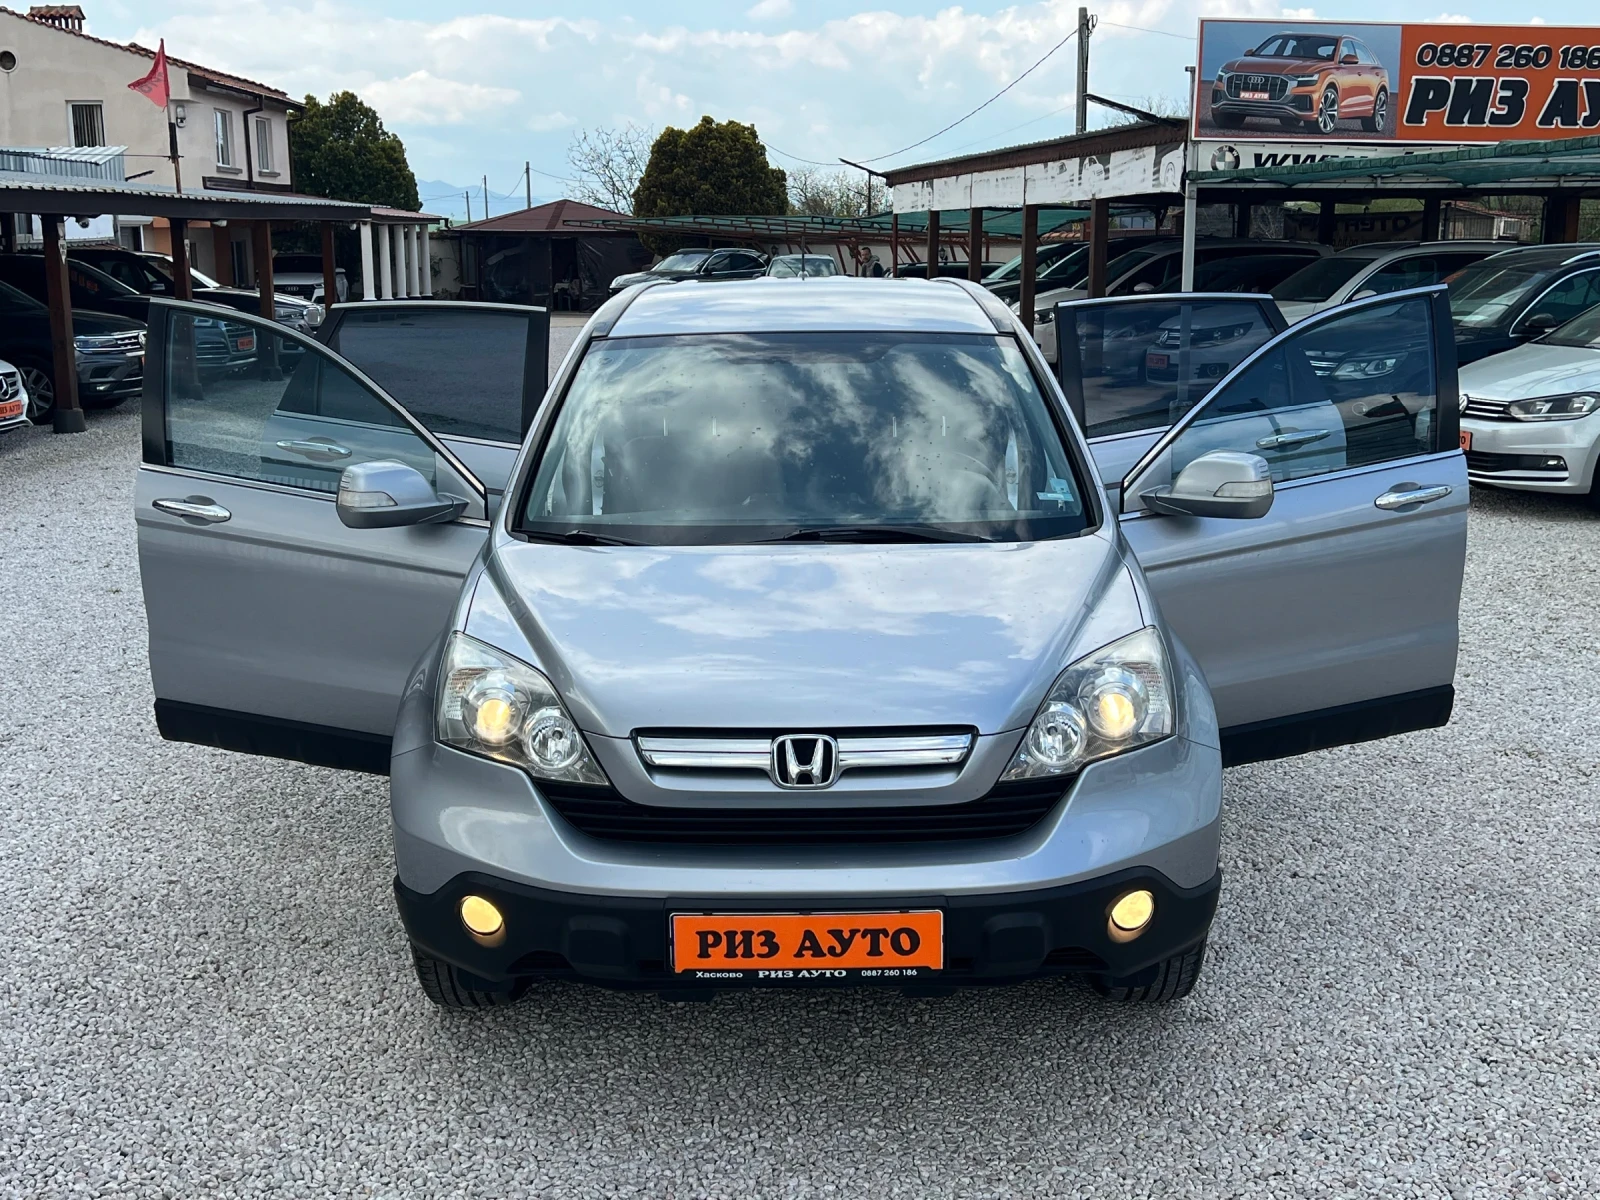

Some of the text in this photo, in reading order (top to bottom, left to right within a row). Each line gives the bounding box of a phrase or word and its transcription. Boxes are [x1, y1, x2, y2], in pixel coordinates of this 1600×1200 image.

[1416, 42, 1600, 71] 0887 260 186
[1403, 75, 1530, 127] РИЗ
[695, 927, 921, 959] РИЗ АУТО
[695, 970, 744, 979] Хасково
[758, 970, 794, 979] РИЗ
[797, 969, 847, 978] АУТО
[861, 969, 882, 977] 0887
[883, 969, 900, 977] 260
